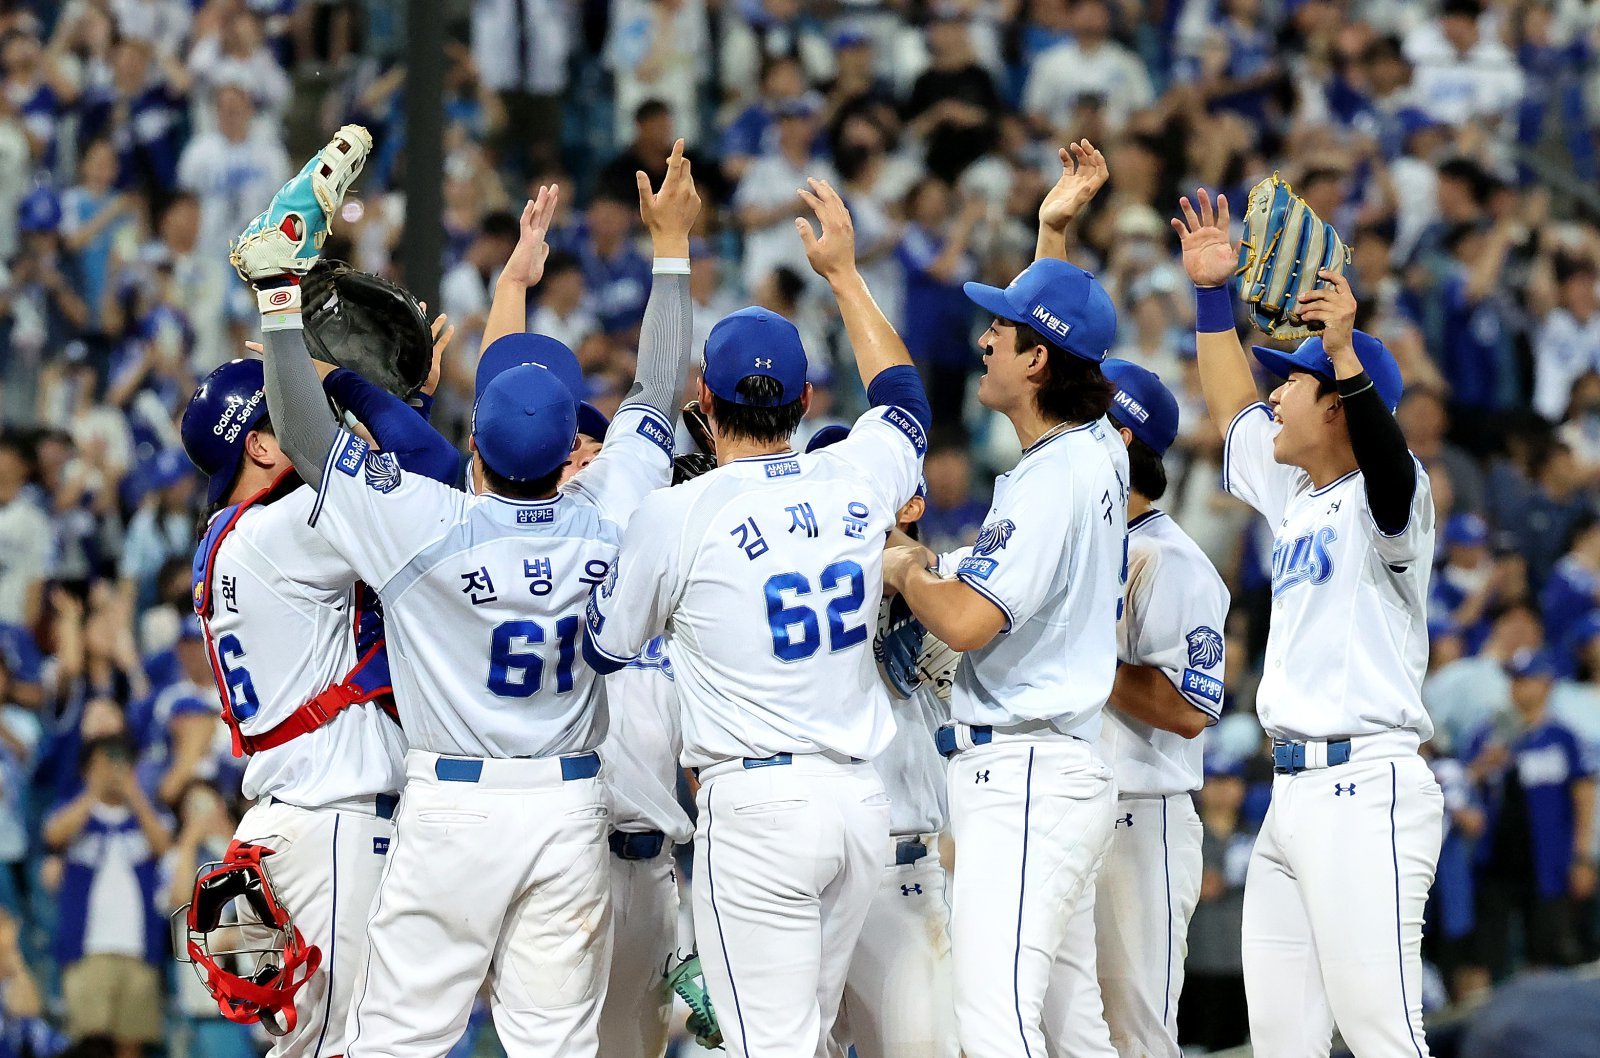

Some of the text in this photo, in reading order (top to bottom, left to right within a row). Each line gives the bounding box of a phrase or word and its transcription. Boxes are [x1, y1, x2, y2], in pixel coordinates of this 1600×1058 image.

[213, 395, 243, 435] Galaxy
[224, 390, 264, 443] S26 Series
[767, 461, 800, 476] 삼성카드
[517, 508, 553, 522] 삼성카드
[763, 559, 868, 664] 62
[486, 613, 580, 697] 61
[1187, 672, 1222, 699] 삼성생명
